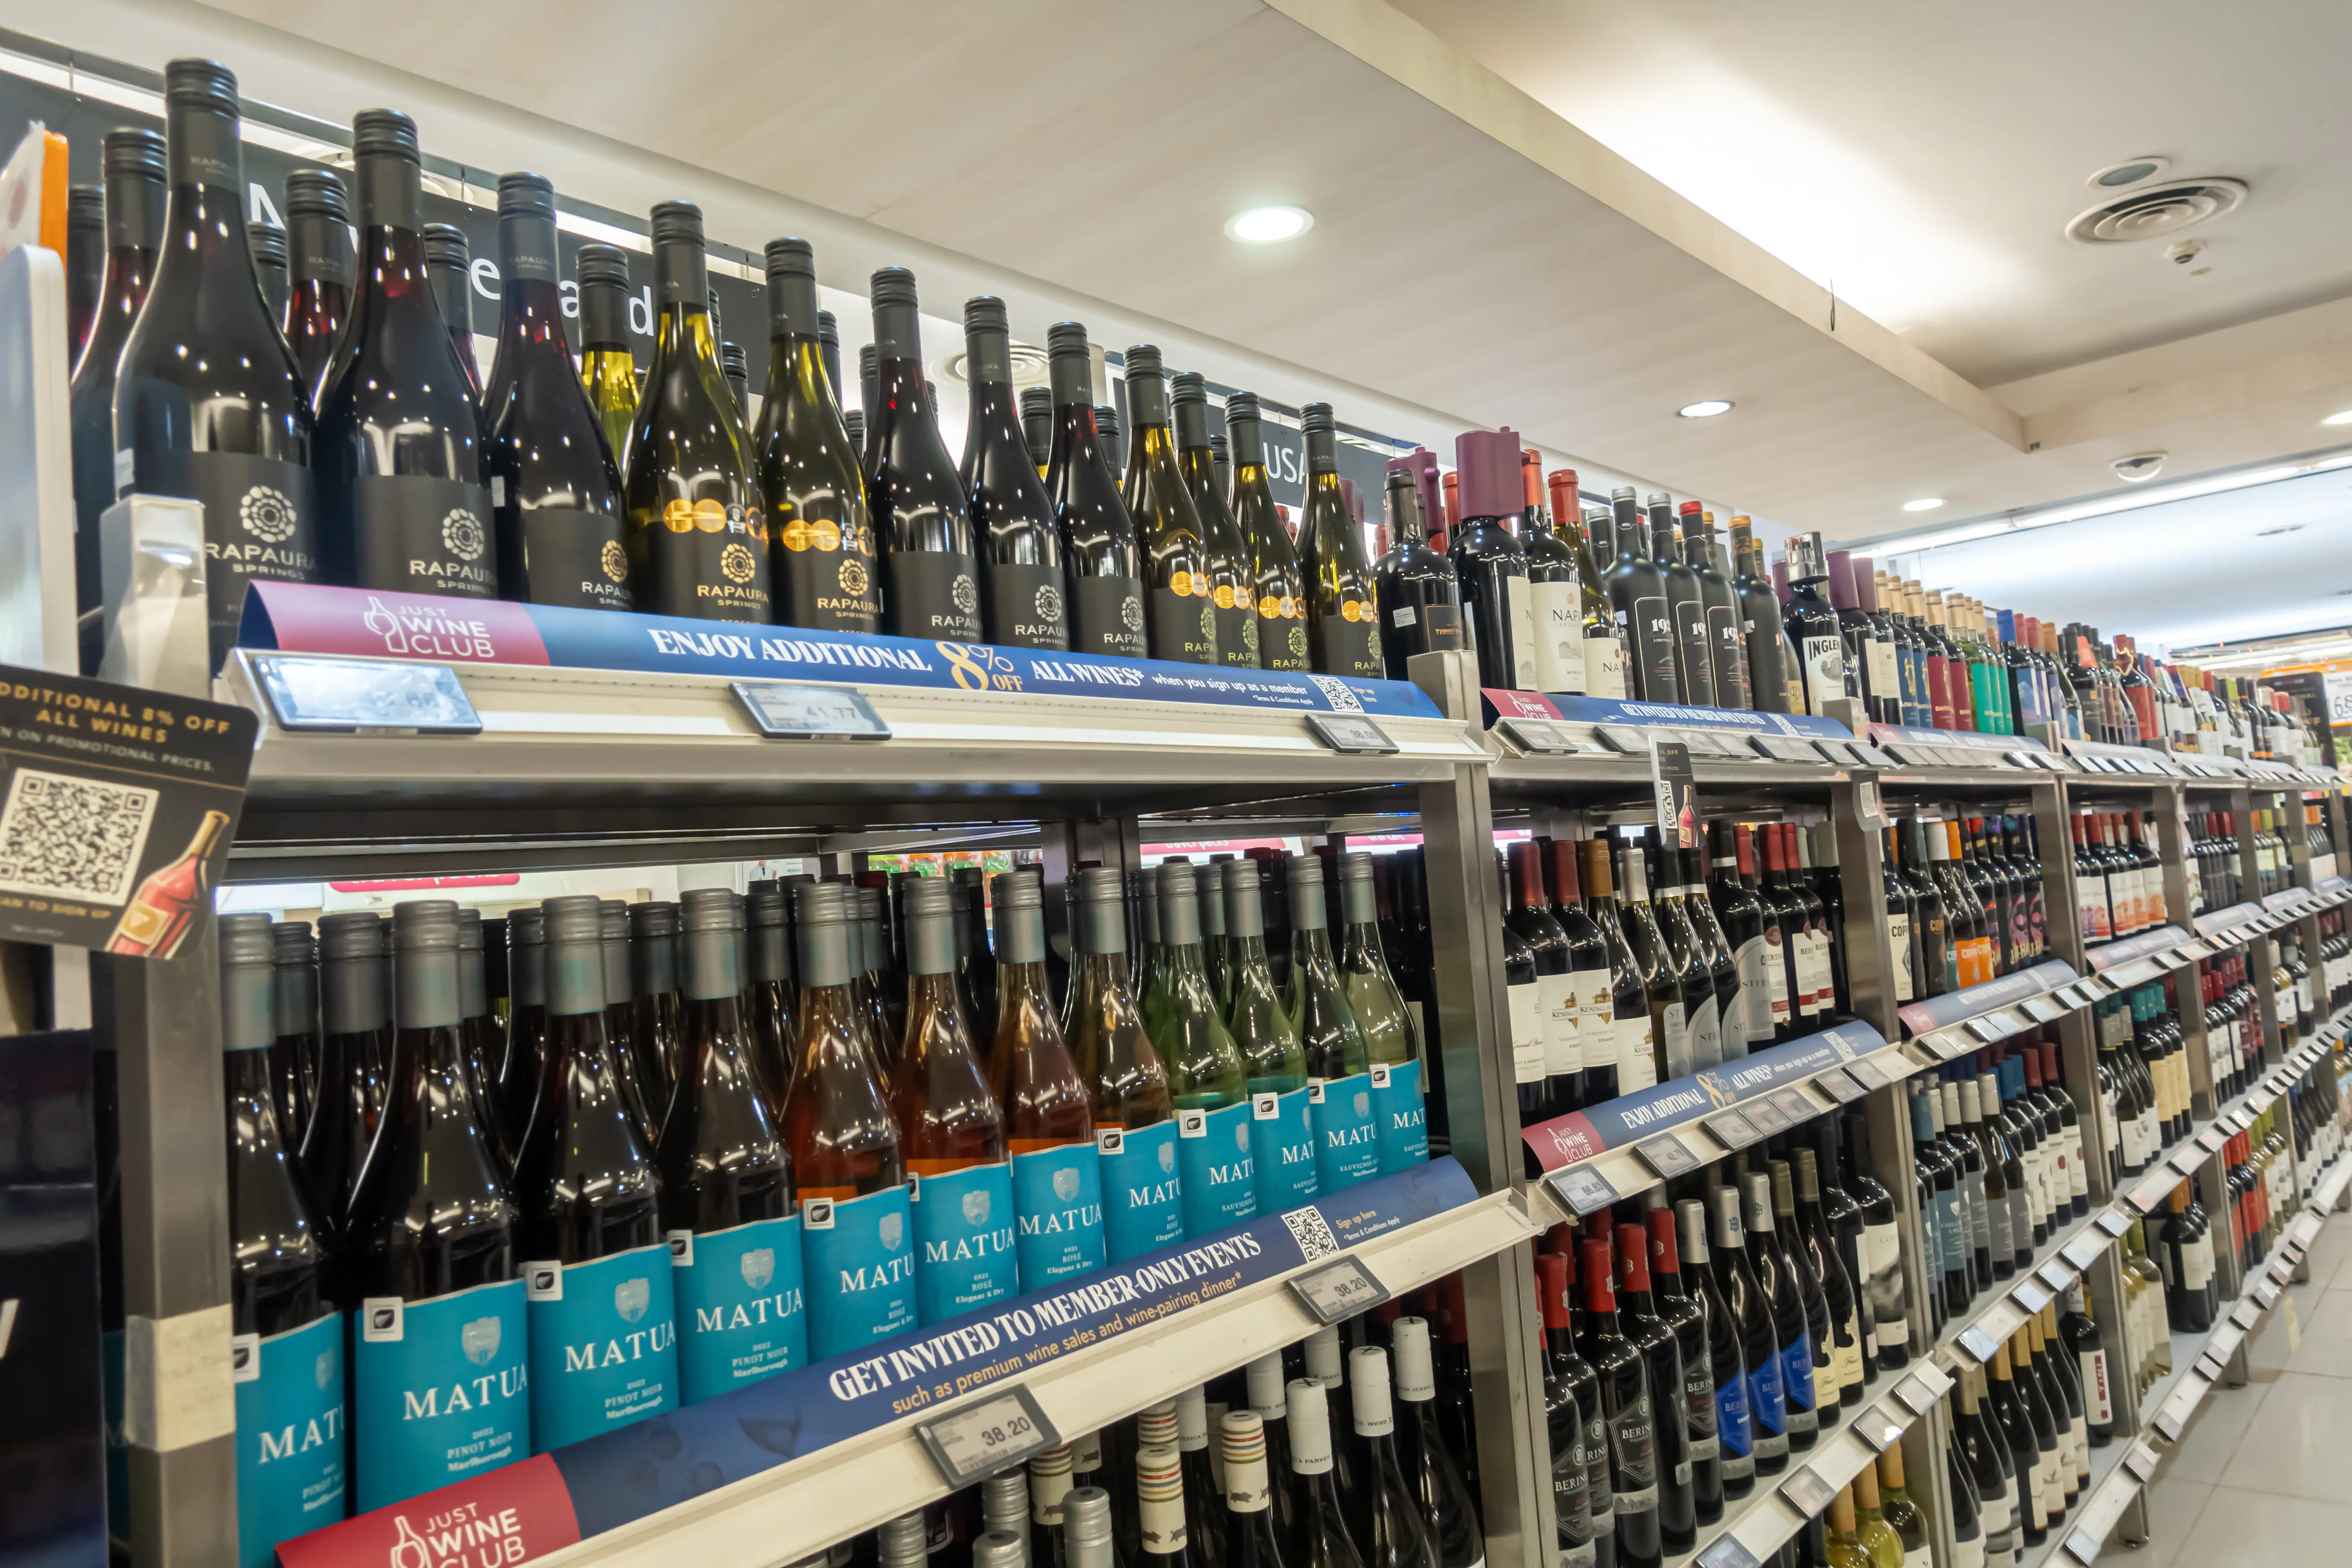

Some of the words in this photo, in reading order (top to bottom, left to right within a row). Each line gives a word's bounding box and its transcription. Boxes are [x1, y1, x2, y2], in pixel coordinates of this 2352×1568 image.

[697, 585, 769, 603] RAPAURA
[398, 605, 447, 617] JUST
[402, 615, 490, 638] WINE
[411, 635, 495, 658] CLUB
[1808, 640, 1839, 662] INGLE
[647, 629, 756, 660] ENJOY
[760, 638, 933, 672] ADDITIONAL
[935, 641, 1014, 690] 8%
[992, 674, 1023, 692] OFF
[1031, 660, 1076, 682] ALL
[1151, 673, 1183, 687] when
[1183, 678, 1205, 689] you
[1206, 677, 1231, 692] sign
[1233, 682, 1246, 694] up
[1248, 682, 1260, 692] as
[1268, 683, 1308, 695] member
[0, 681, 132, 718] DDITIONAL
[142, 707, 175, 725] 8%
[185, 714, 230, 735] OFF
[1275, 696, 1300, 704] Conditions
[1300, 698, 1314, 706] Apply
[1524, 704, 1548, 713] WINE
[35, 709, 80, 728] ALL
[91, 717, 168, 744] WINES
[1620, 1105, 1656, 1129] ENJOY
[1651, 1088, 1706, 1119] ADDITIONAL
[1696, 1071, 1730, 1110] 8%
[1731, 1073, 1752, 1090] ALL
[1327, 1122, 1376, 1147] MATU
[1562, 1132, 1588, 1148] WINE
[1570, 1144, 1593, 1160] CLUB
[1129, 1176, 1181, 1208] MATU
[1019, 1202, 1102, 1236] MATUA
[925, 1225, 1015, 1263] MATUA
[1047, 1263, 1075, 1275] Elegant
[1082, 1259, 1093, 1269] Dry
[1062, 1251, 1081, 1264] ROSÉ
[839, 1252, 915, 1294] MATU
[971, 1279, 993, 1292] ROSÉ
[956, 1291, 986, 1304] Elegant
[993, 1286, 1004, 1297] Dry
[1333, 1277, 1368, 1298] 38.20
[696, 1287, 803, 1333] MATUA
[829, 1356, 892, 1401] GET
[888, 1321, 1001, 1381] INVITED
[994, 1309, 1036, 1343] TO
[1032, 1253, 1195, 1331] MEMBER-ONLY
[1190, 1231, 1262, 1275] EVENTS
[1335, 1215, 1352, 1230] Sign
[1352, 1213, 1363, 1227] up
[1362, 1208, 1377, 1223] here
[892, 1384, 931, 1415] such
[934, 1381, 953, 1400] as
[956, 1356, 1024, 1396] premium
[1025, 1342, 1060, 1365] wine
[1062, 1327, 1096, 1351] sales
[1099, 1311, 1124, 1337] and
[1124, 1288, 1200, 1327] wine-pairing
[1360, 1227, 1365, 1235] &
[1364, 1220, 1388, 1235] Conditions
[1387, 1216, 1400, 1229] Apply
[564, 1319, 676, 1372] MATUA
[732, 1353, 764, 1367] PINOT
[403, 1363, 528, 1421] MATUA
[980, 1415, 1032, 1447] 38.20
[1305, 1454, 1331, 1465] PARKER
[426, 1502, 478, 1533] JUST
[428, 1507, 522, 1558] WINE
